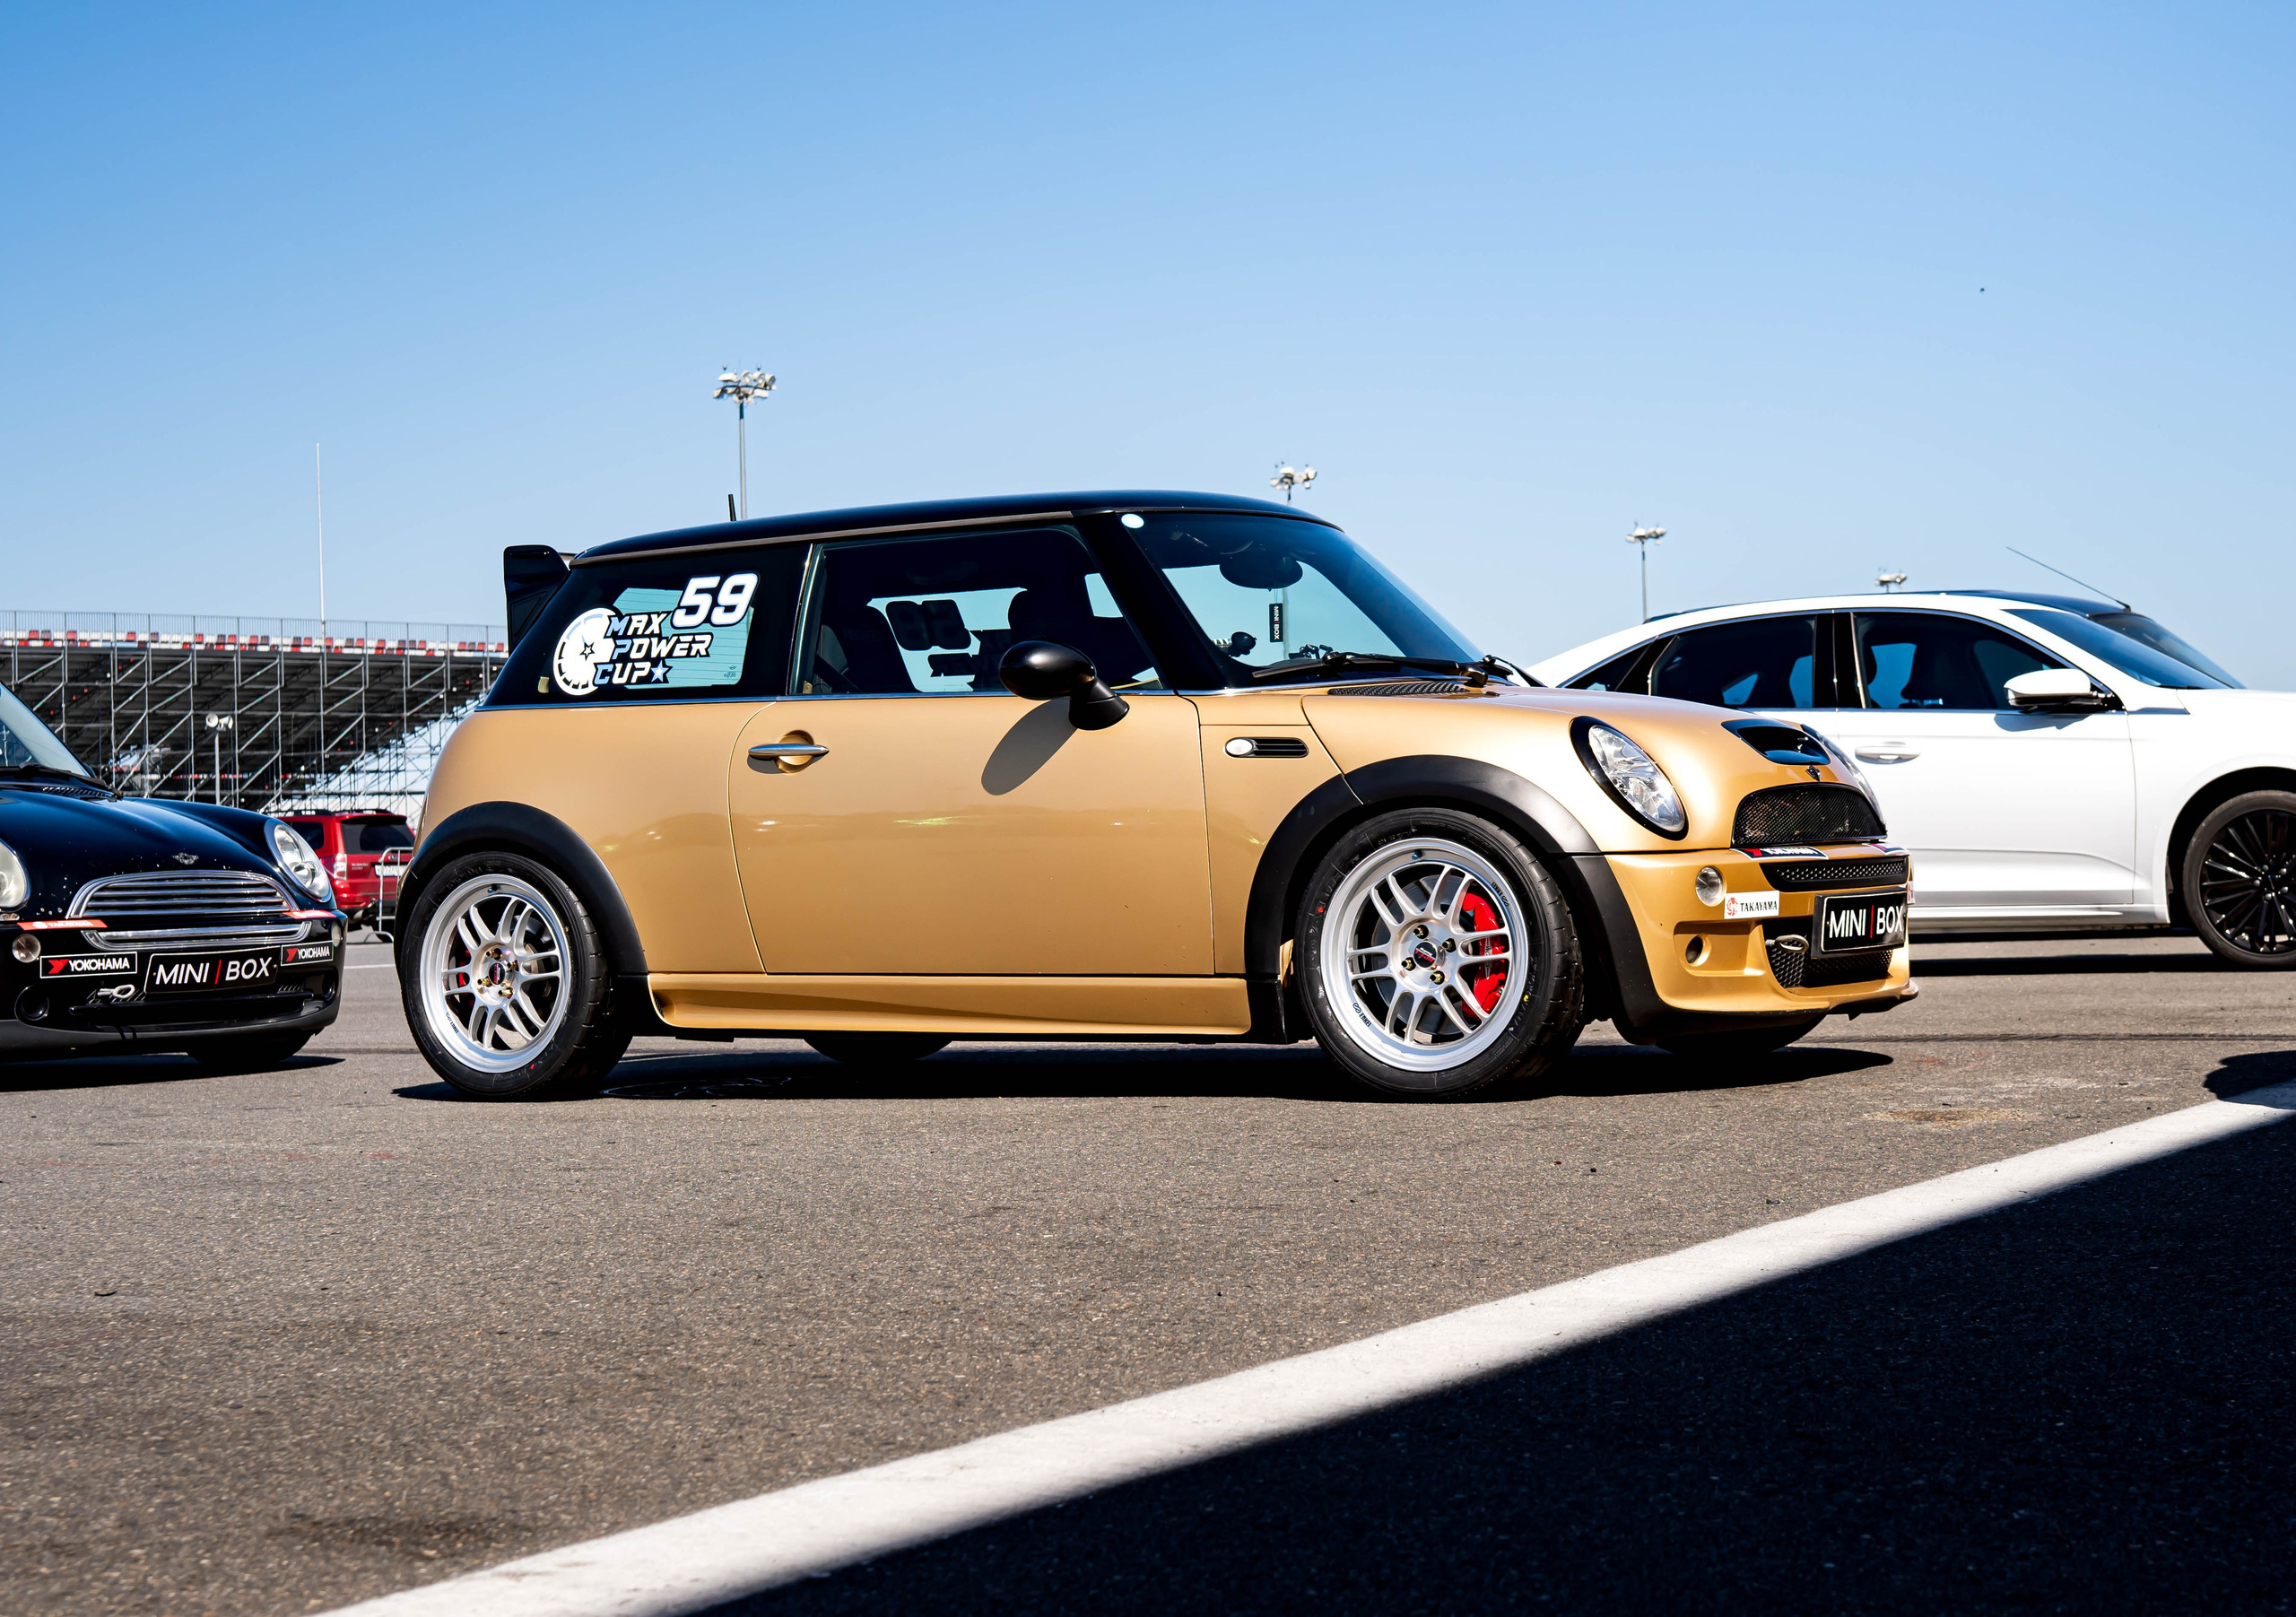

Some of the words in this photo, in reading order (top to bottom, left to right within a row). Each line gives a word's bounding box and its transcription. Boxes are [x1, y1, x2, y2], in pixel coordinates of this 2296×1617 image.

[672, 572, 760, 629] 59
[605, 613, 668, 637] MAX
[613, 633, 713, 660] POWER
[593, 661, 652, 685] CUP
[1739, 900, 1779, 912] TAKAYAMA
[1829, 908, 1867, 939] MINI
[1875, 905, 1903, 934] BOX
[68, 956, 131, 972] YOKOHAMA
[297, 945, 331, 960] YOKOHAMA
[154, 962, 211, 986] MINI
[225, 957, 273, 982] BOX
